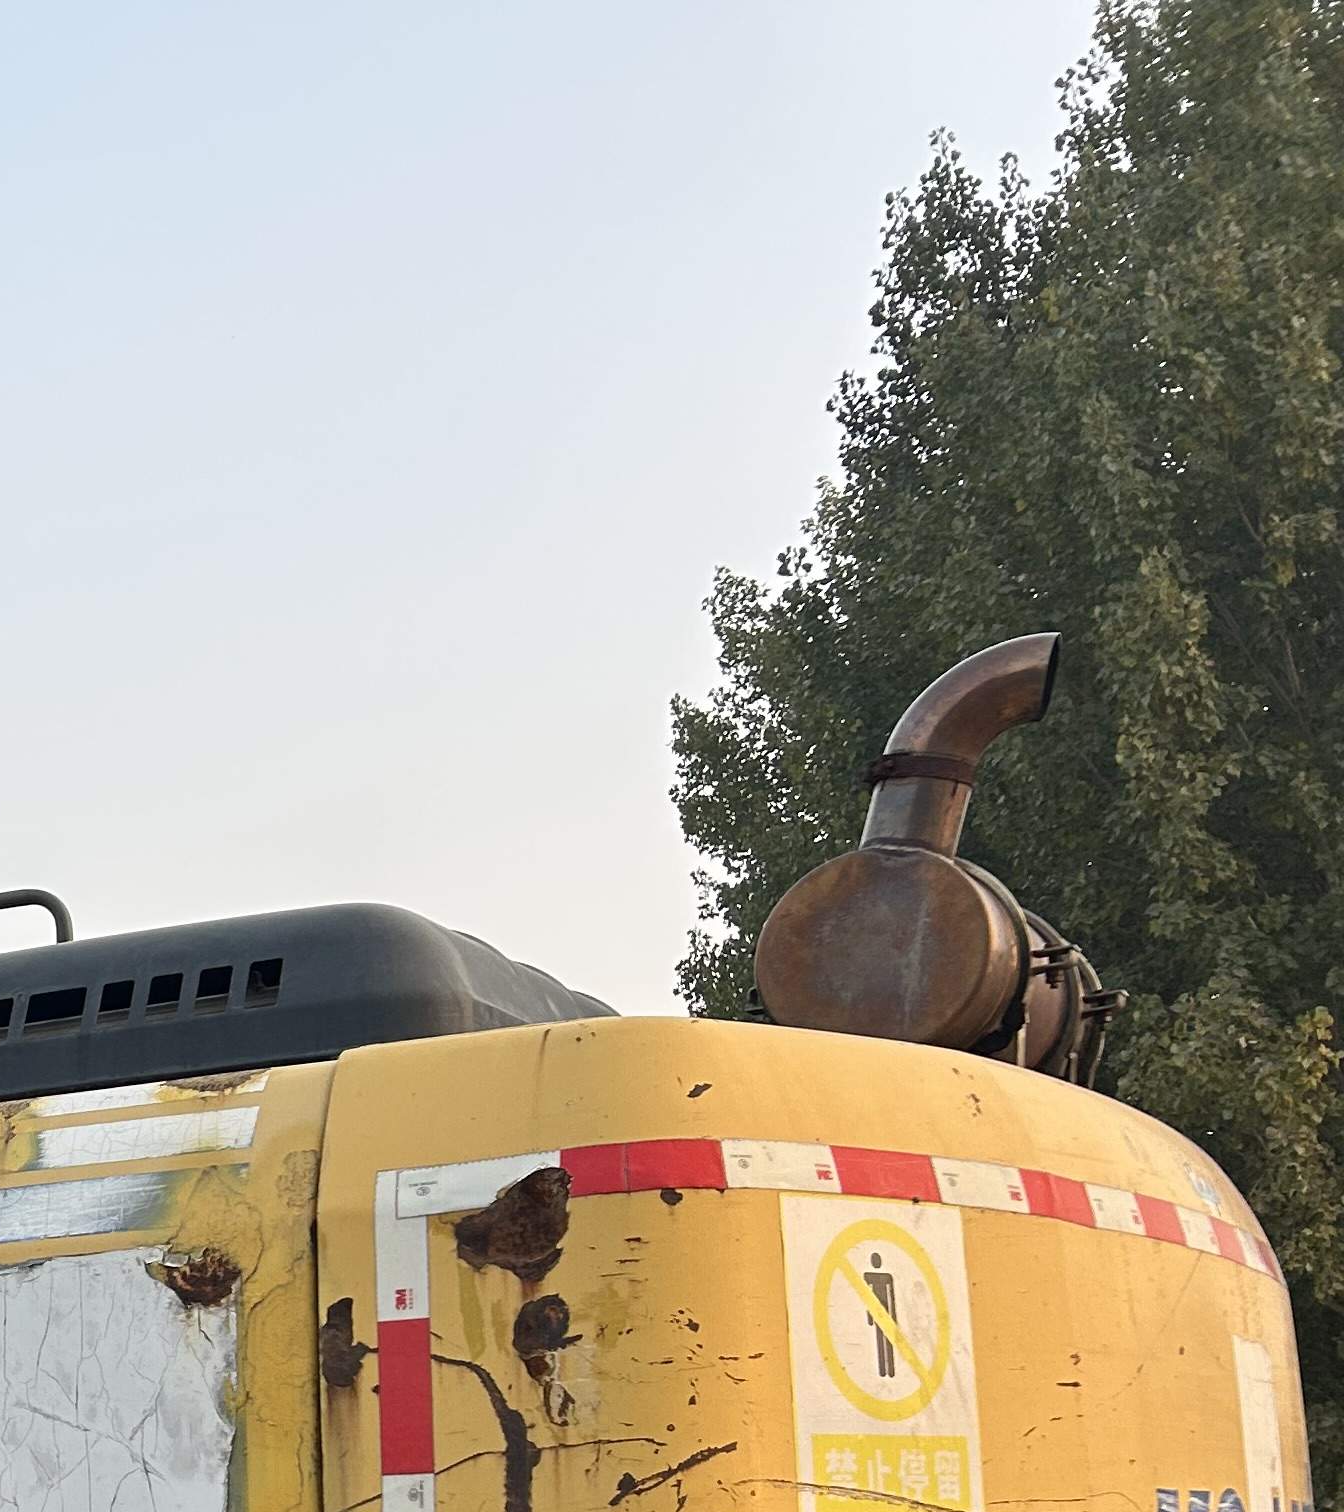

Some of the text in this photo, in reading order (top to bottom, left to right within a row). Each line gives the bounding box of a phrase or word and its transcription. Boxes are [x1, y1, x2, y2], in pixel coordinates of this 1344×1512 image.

[395, 1288, 408, 1310] 3M
[824, 1450, 963, 1504] 禁止停留
